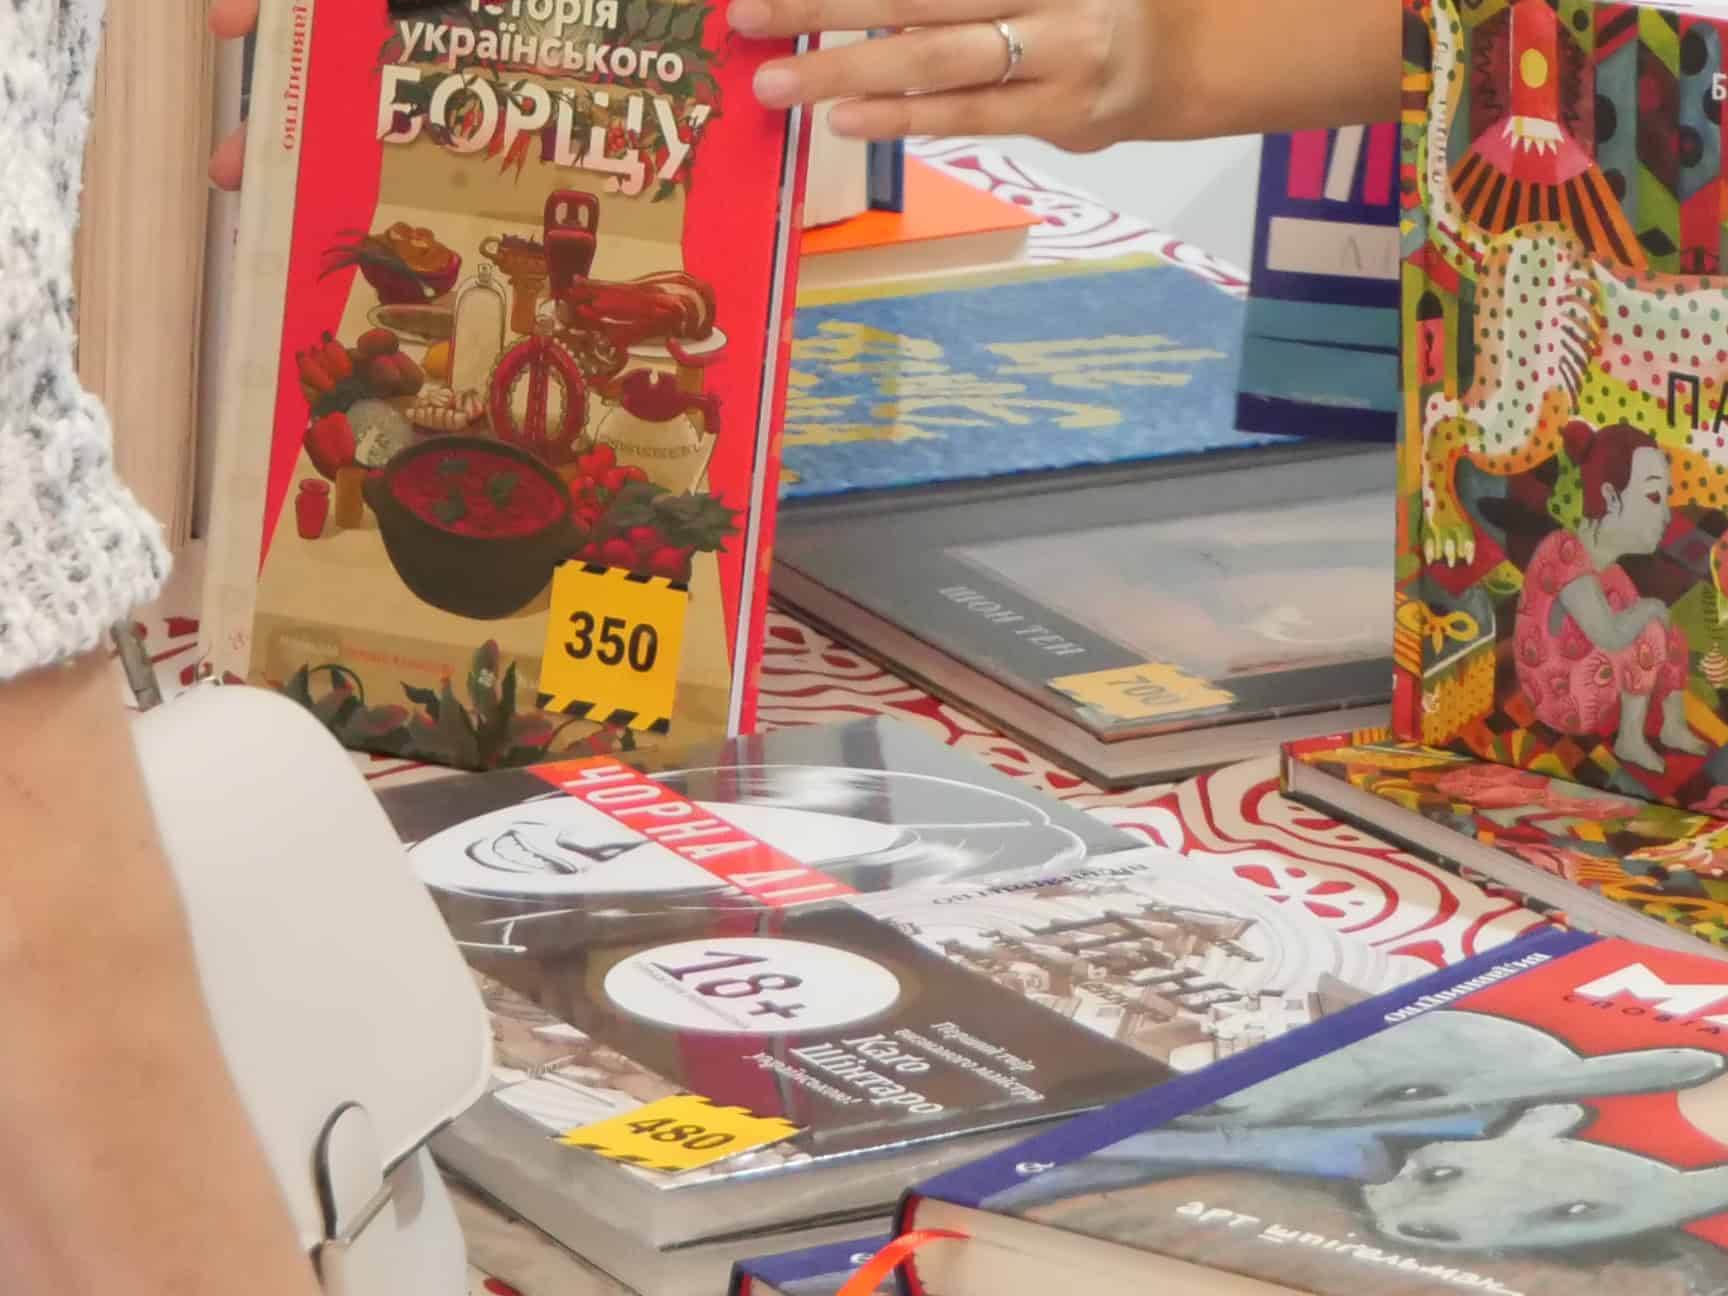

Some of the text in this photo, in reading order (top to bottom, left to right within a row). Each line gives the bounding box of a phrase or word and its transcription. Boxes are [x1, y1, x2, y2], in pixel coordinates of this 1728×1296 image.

[399, 20, 684, 84] українського
[376, 64, 712, 196] БОРЩУ
[563, 611, 658, 673] 350
[939, 586, 1086, 656] ШОН ТЕН
[560, 765, 850, 908] ЧОРНА ДІ
[650, 951, 806, 1019] 18+
[790, 1042, 944, 1113] Шінтаро
[626, 1118, 736, 1150] 480
